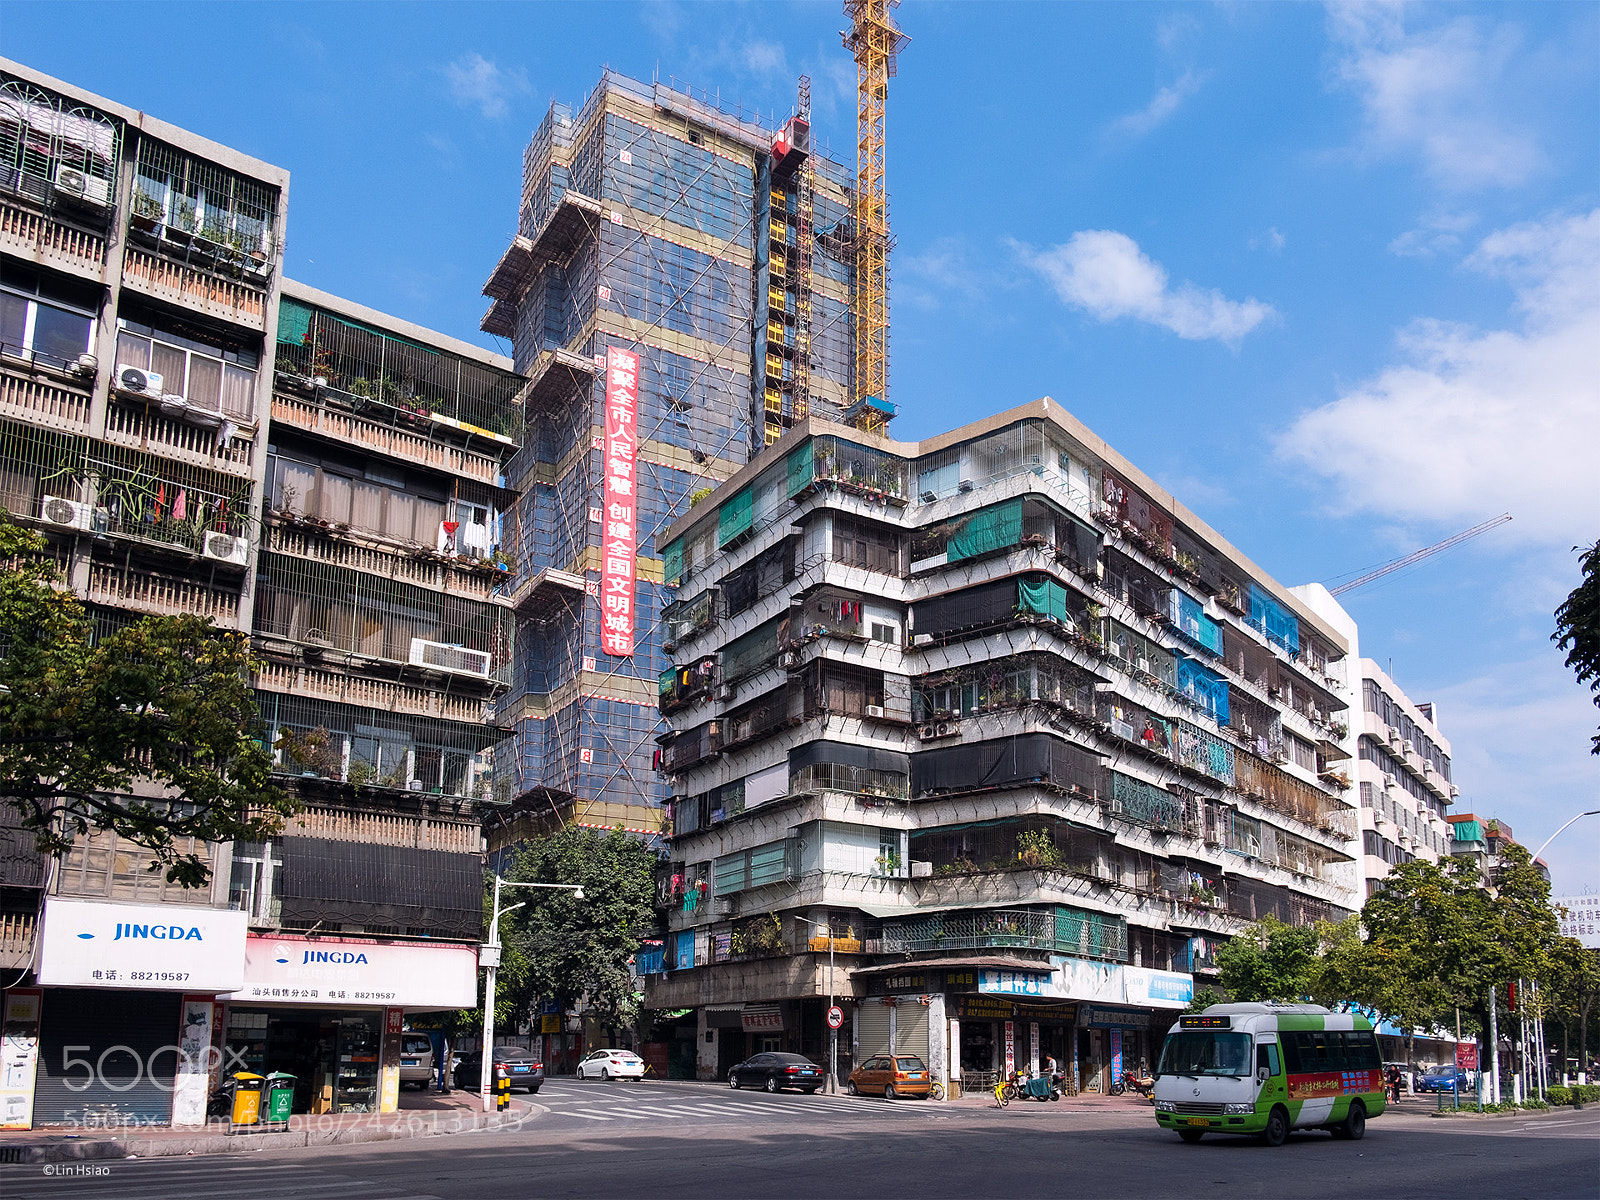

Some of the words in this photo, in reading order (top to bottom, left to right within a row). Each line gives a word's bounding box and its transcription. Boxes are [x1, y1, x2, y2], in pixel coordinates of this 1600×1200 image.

[621, 151, 630, 162] 24
[612, 212, 622, 223] 22
[599, 287, 610, 299] 20
[596, 356, 605, 368] 18
[608, 352, 636, 496] 凝聚全市人民智慧
[605, 502, 633, 651] 创建全国文明城市
[585, 658, 595, 670] 10
[583, 750, 591, 762] 8
[1561, 909, 1600, 921] 驶机动车
[113, 923, 203, 941] JINGDA
[302, 950, 368, 964] JINGDA
[130, 971, 190, 981] 88219587
[252, 987, 319, 999] 汕头销售分公司
[354, 992, 396, 1000] 88219587
